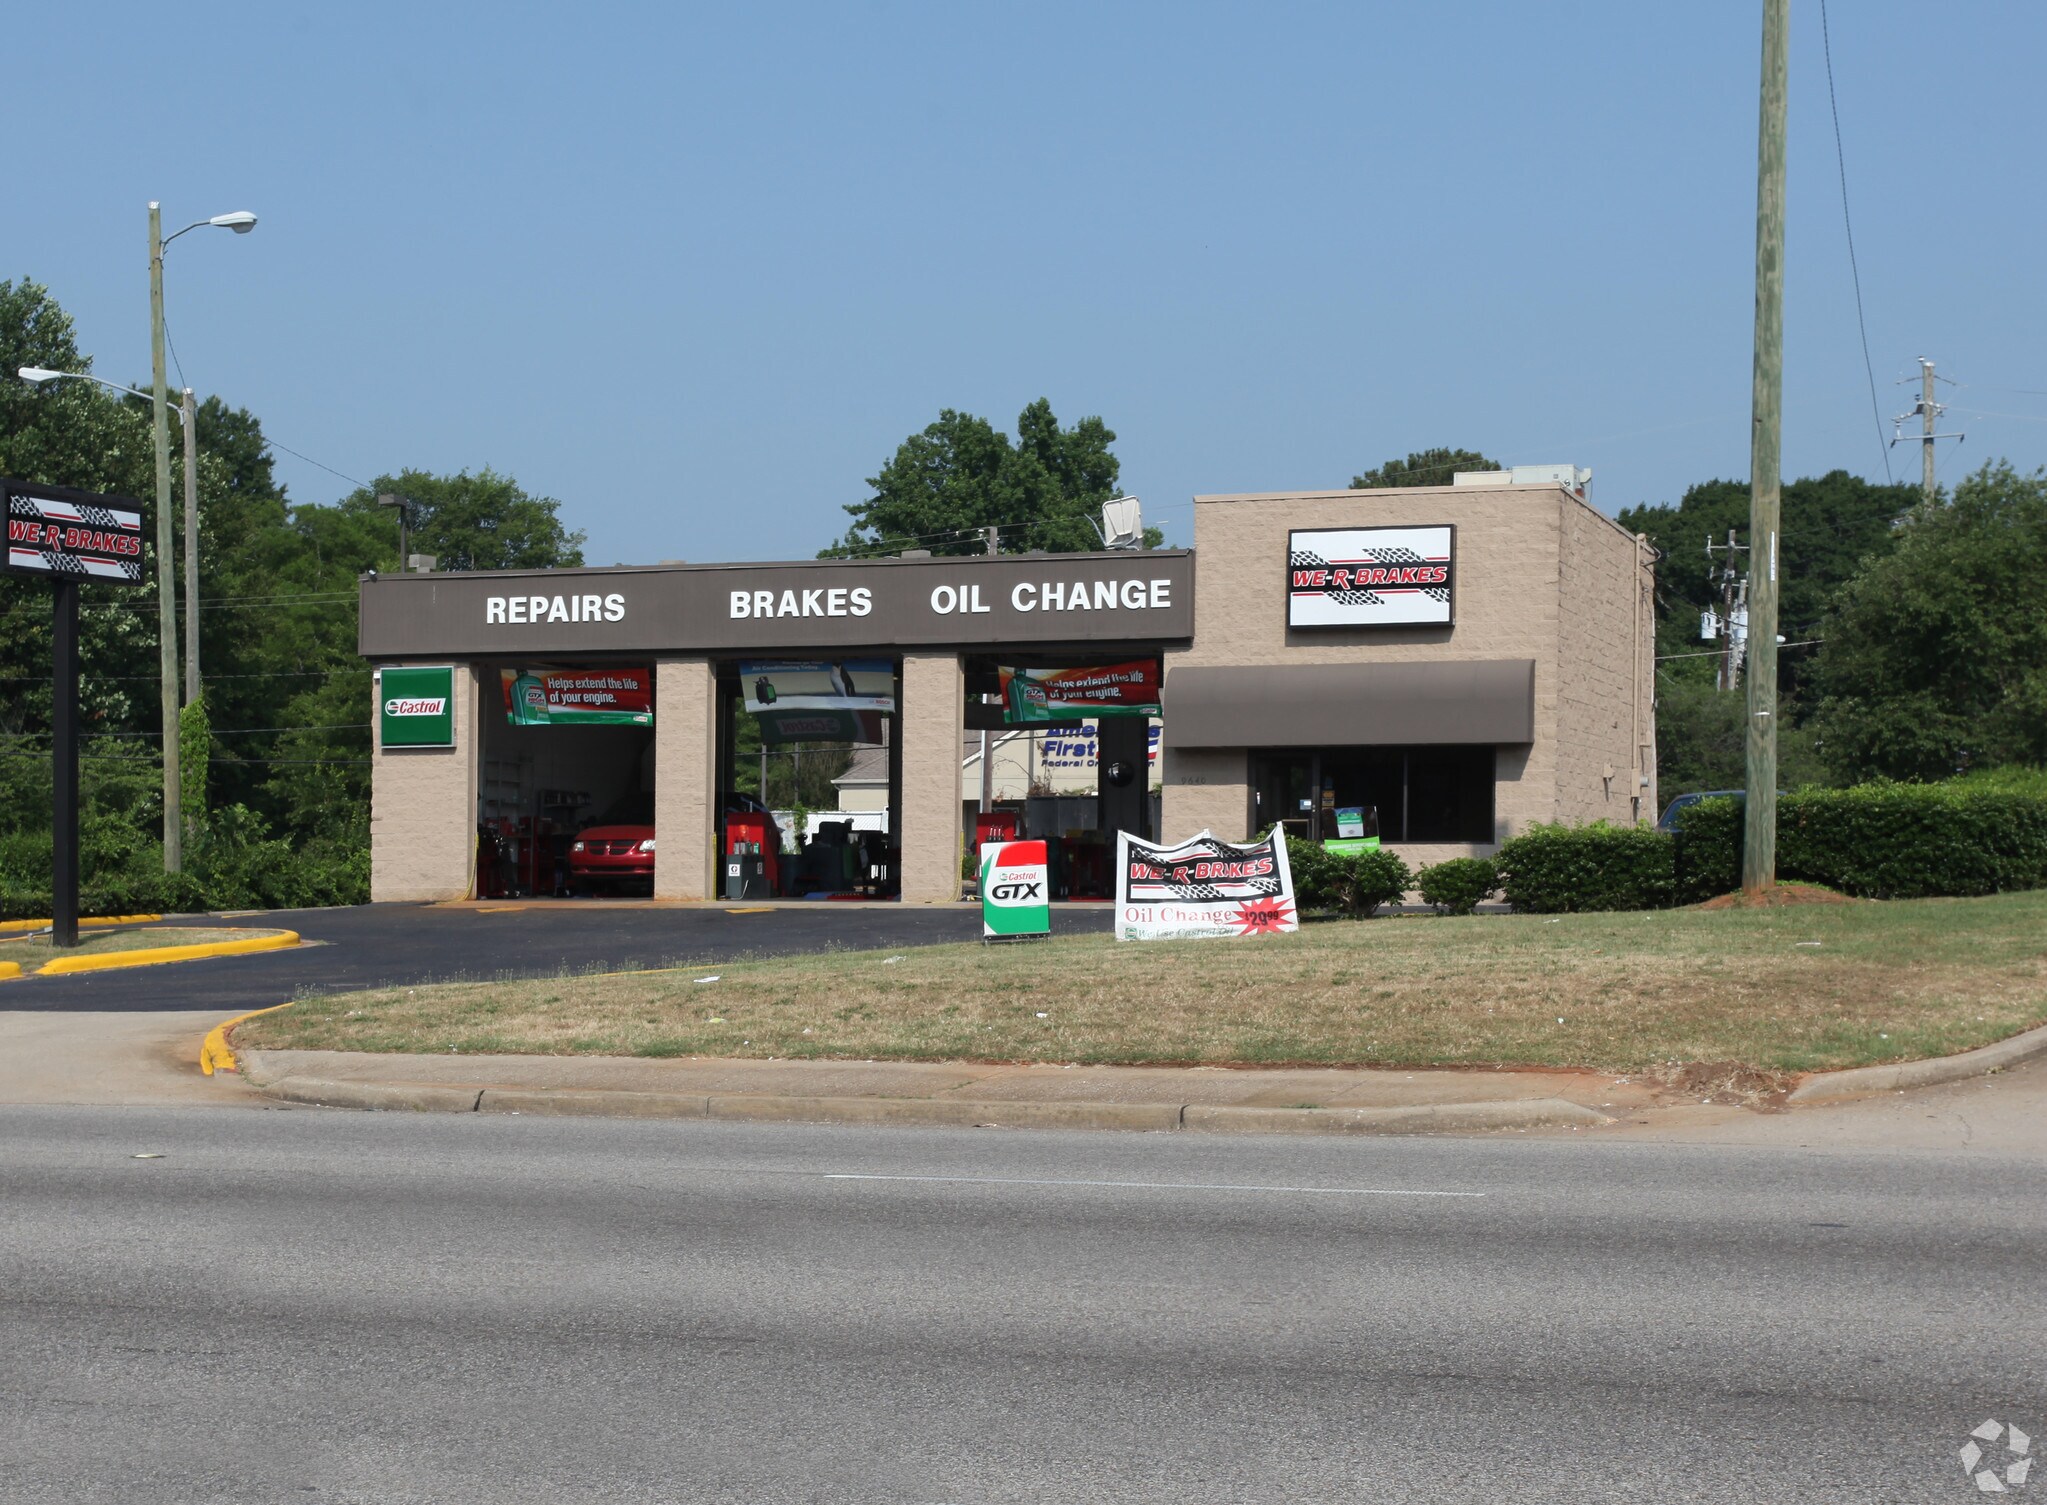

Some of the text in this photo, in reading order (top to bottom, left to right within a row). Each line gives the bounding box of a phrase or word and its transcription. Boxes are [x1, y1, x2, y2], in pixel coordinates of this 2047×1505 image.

[9, 519, 141, 556] WE-R-BRAKES
[1293, 566, 1448, 590] WE-R-BRAKES
[729, 587, 873, 619] BRAKES
[930, 579, 1172, 615] OIL CHANGE
[486, 593, 626, 625] REPAIRS
[547, 677, 638, 691] Helps extend the life
[1076, 675, 1111, 688] extend
[1111, 673, 1130, 682] the
[1130, 670, 1144, 682] life
[549, 691, 617, 705] of your engine.
[1049, 687, 1122, 701] of your engine.
[399, 700, 441, 714] Castrol
[1043, 740, 1096, 757] First
[1041, 759, 1083, 767] Federal
[1008, 872, 1037, 881] Castrol
[992, 882, 1042, 901] GTX
[1125, 907, 1232, 925] Oil Change
